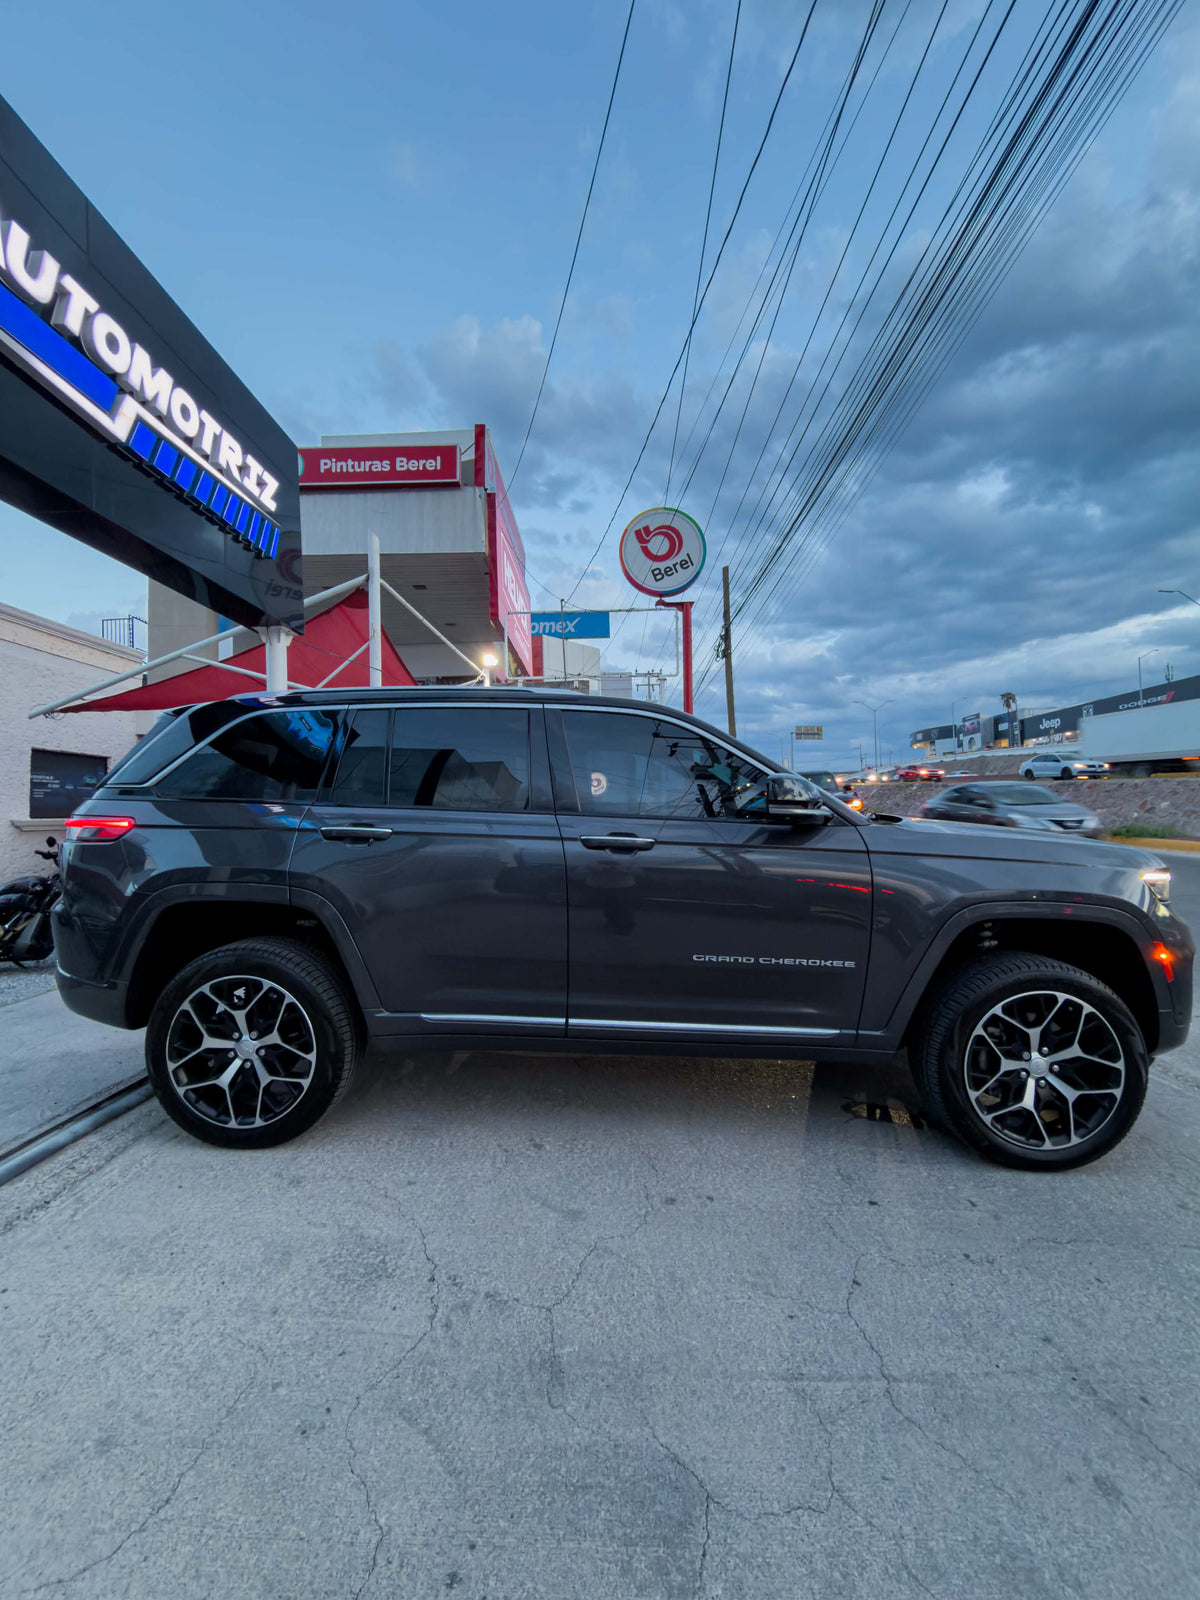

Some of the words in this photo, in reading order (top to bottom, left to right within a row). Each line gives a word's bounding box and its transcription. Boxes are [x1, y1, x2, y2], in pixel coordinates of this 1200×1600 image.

[0, 219, 280, 513] UTOMOTRIZ
[319, 458, 390, 473] Pinturas
[395, 456, 441, 471] Berel
[651, 553, 694, 582] Berel
[531, 616, 581, 634] omex
[1040, 718, 1061, 729] Jeep
[692, 954, 755, 964] GRAND
[758, 957, 856, 968] CHEROKEE
